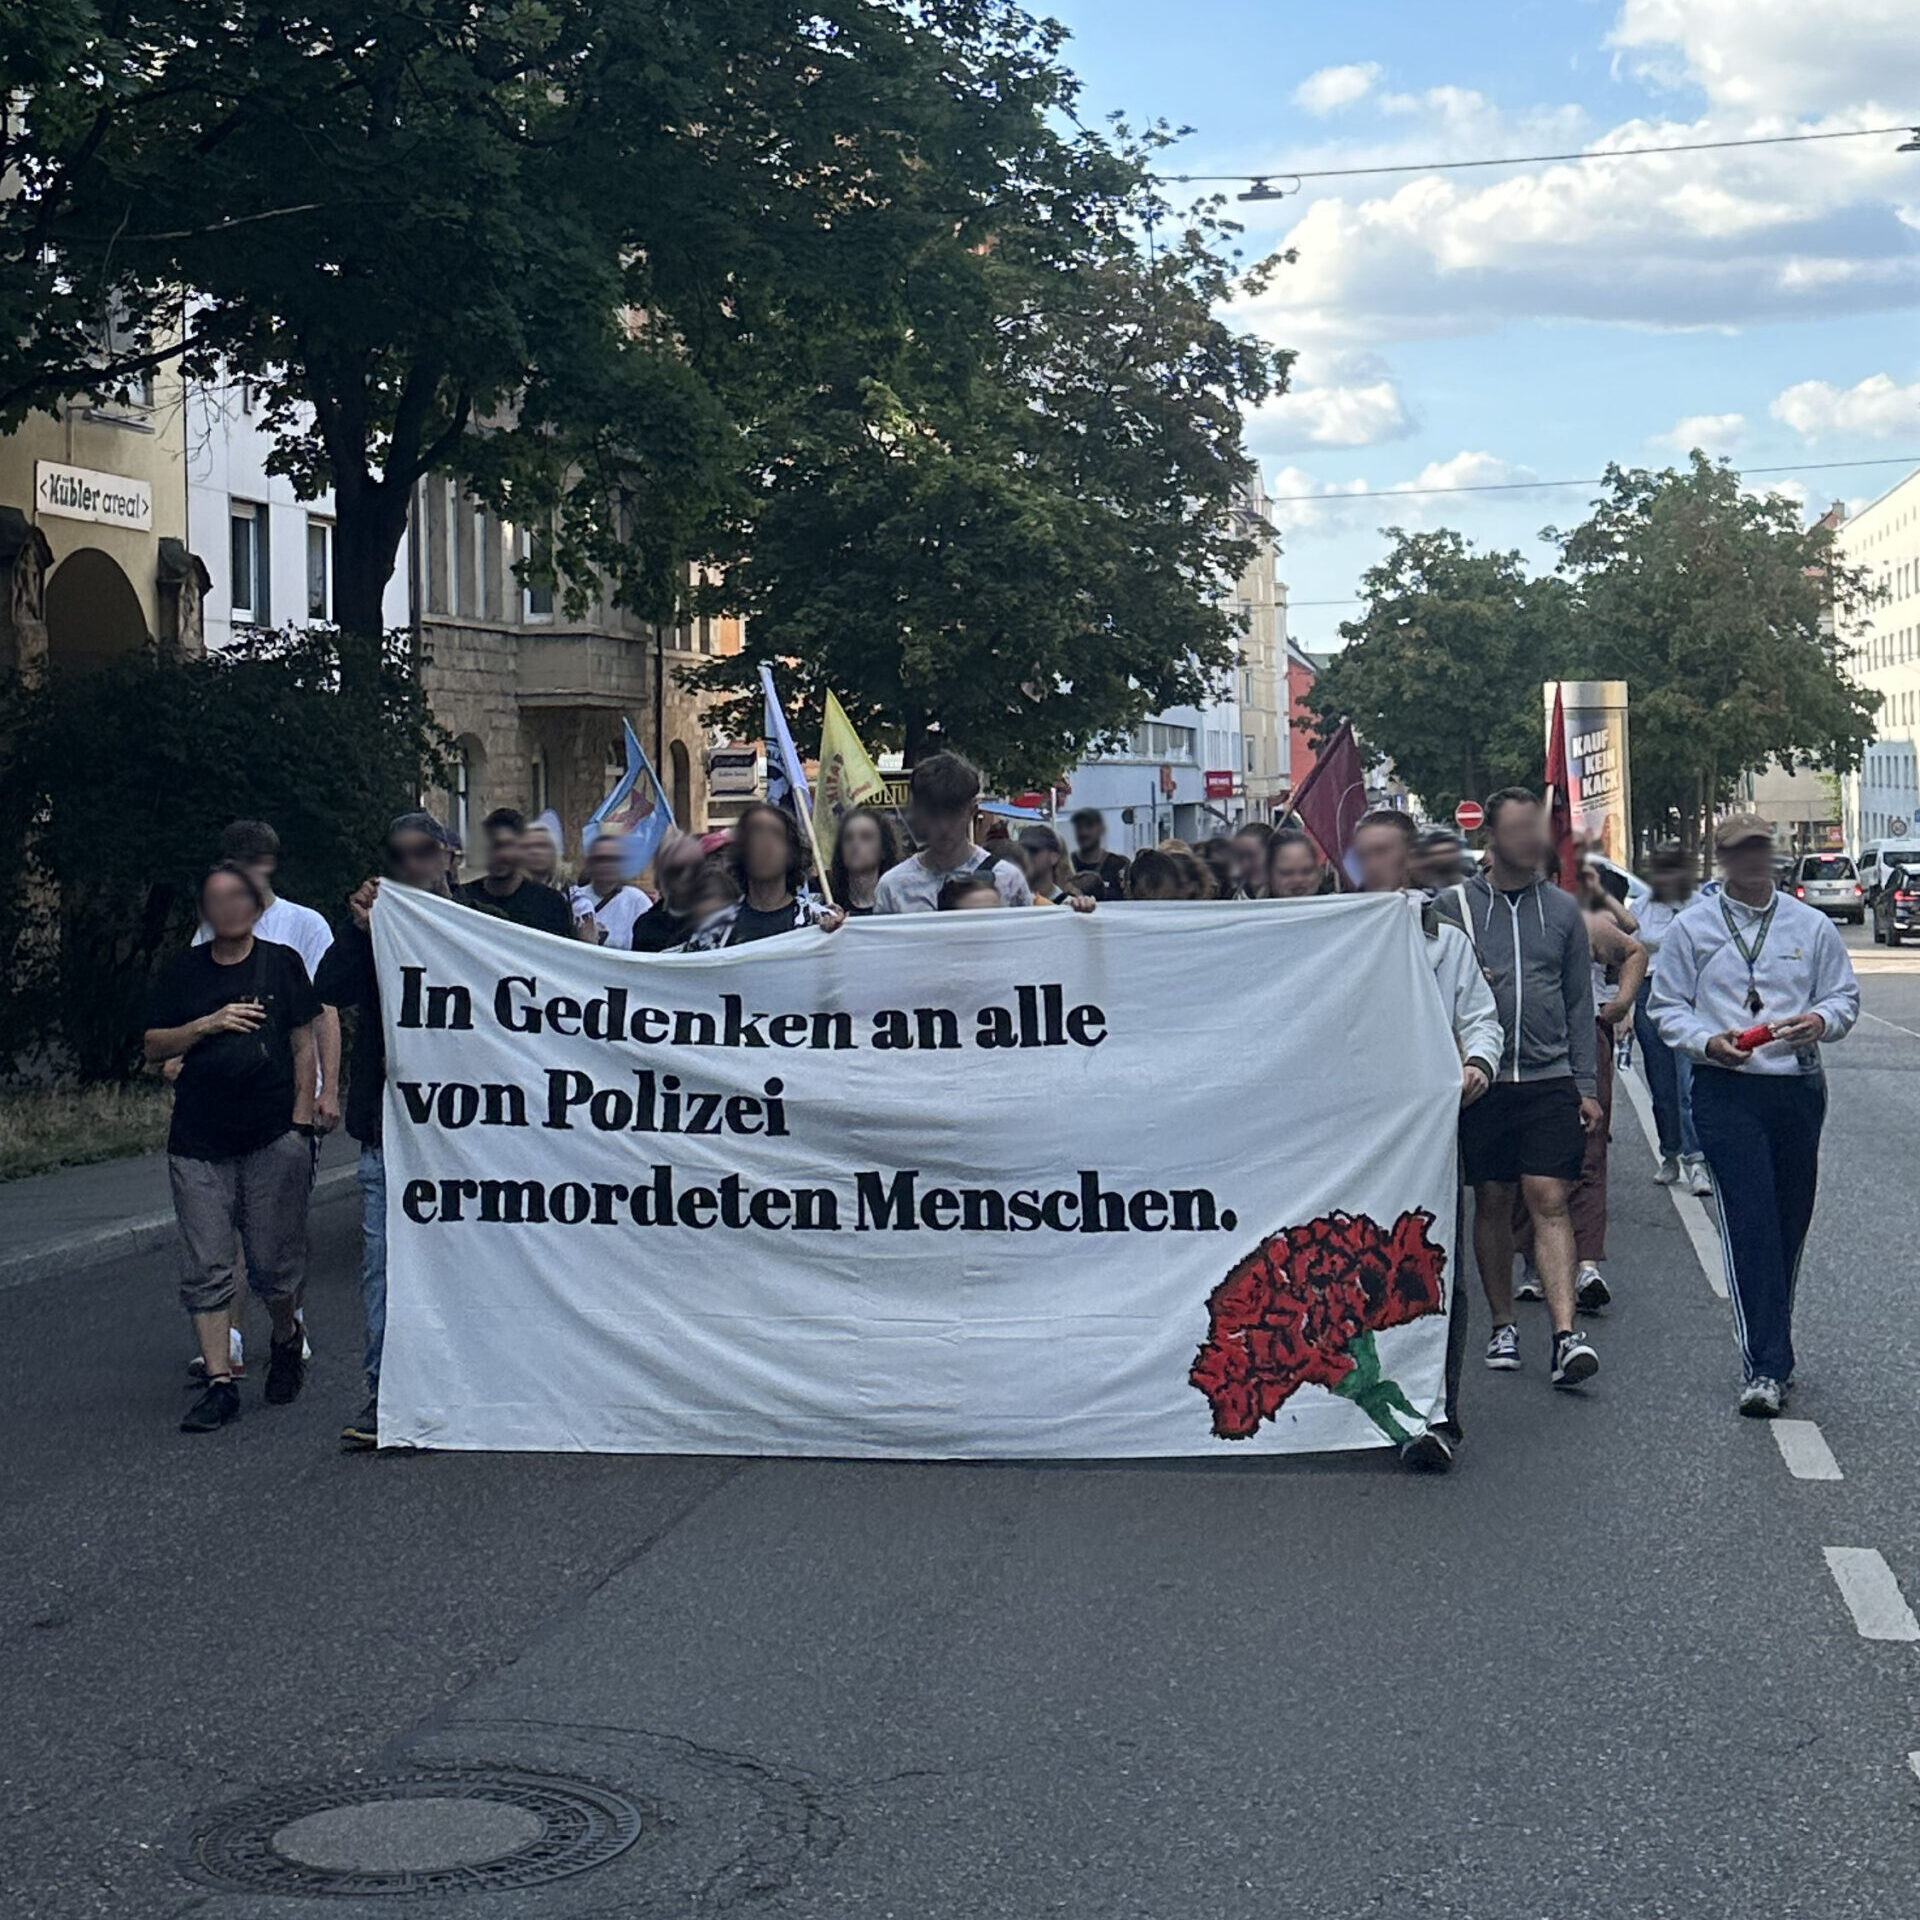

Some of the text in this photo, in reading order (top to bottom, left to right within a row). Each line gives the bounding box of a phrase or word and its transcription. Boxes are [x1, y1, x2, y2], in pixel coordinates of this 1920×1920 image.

[1572, 730, 1608, 758] KAUF
[1584, 748, 1616, 775] KEIN
[1582, 769, 1618, 797] KACK
[397, 967, 1107, 1050] In Gedenken an alle
[397, 1069, 790, 1136] von Polizei
[403, 1165, 1237, 1232] ermordeten Menschen.
